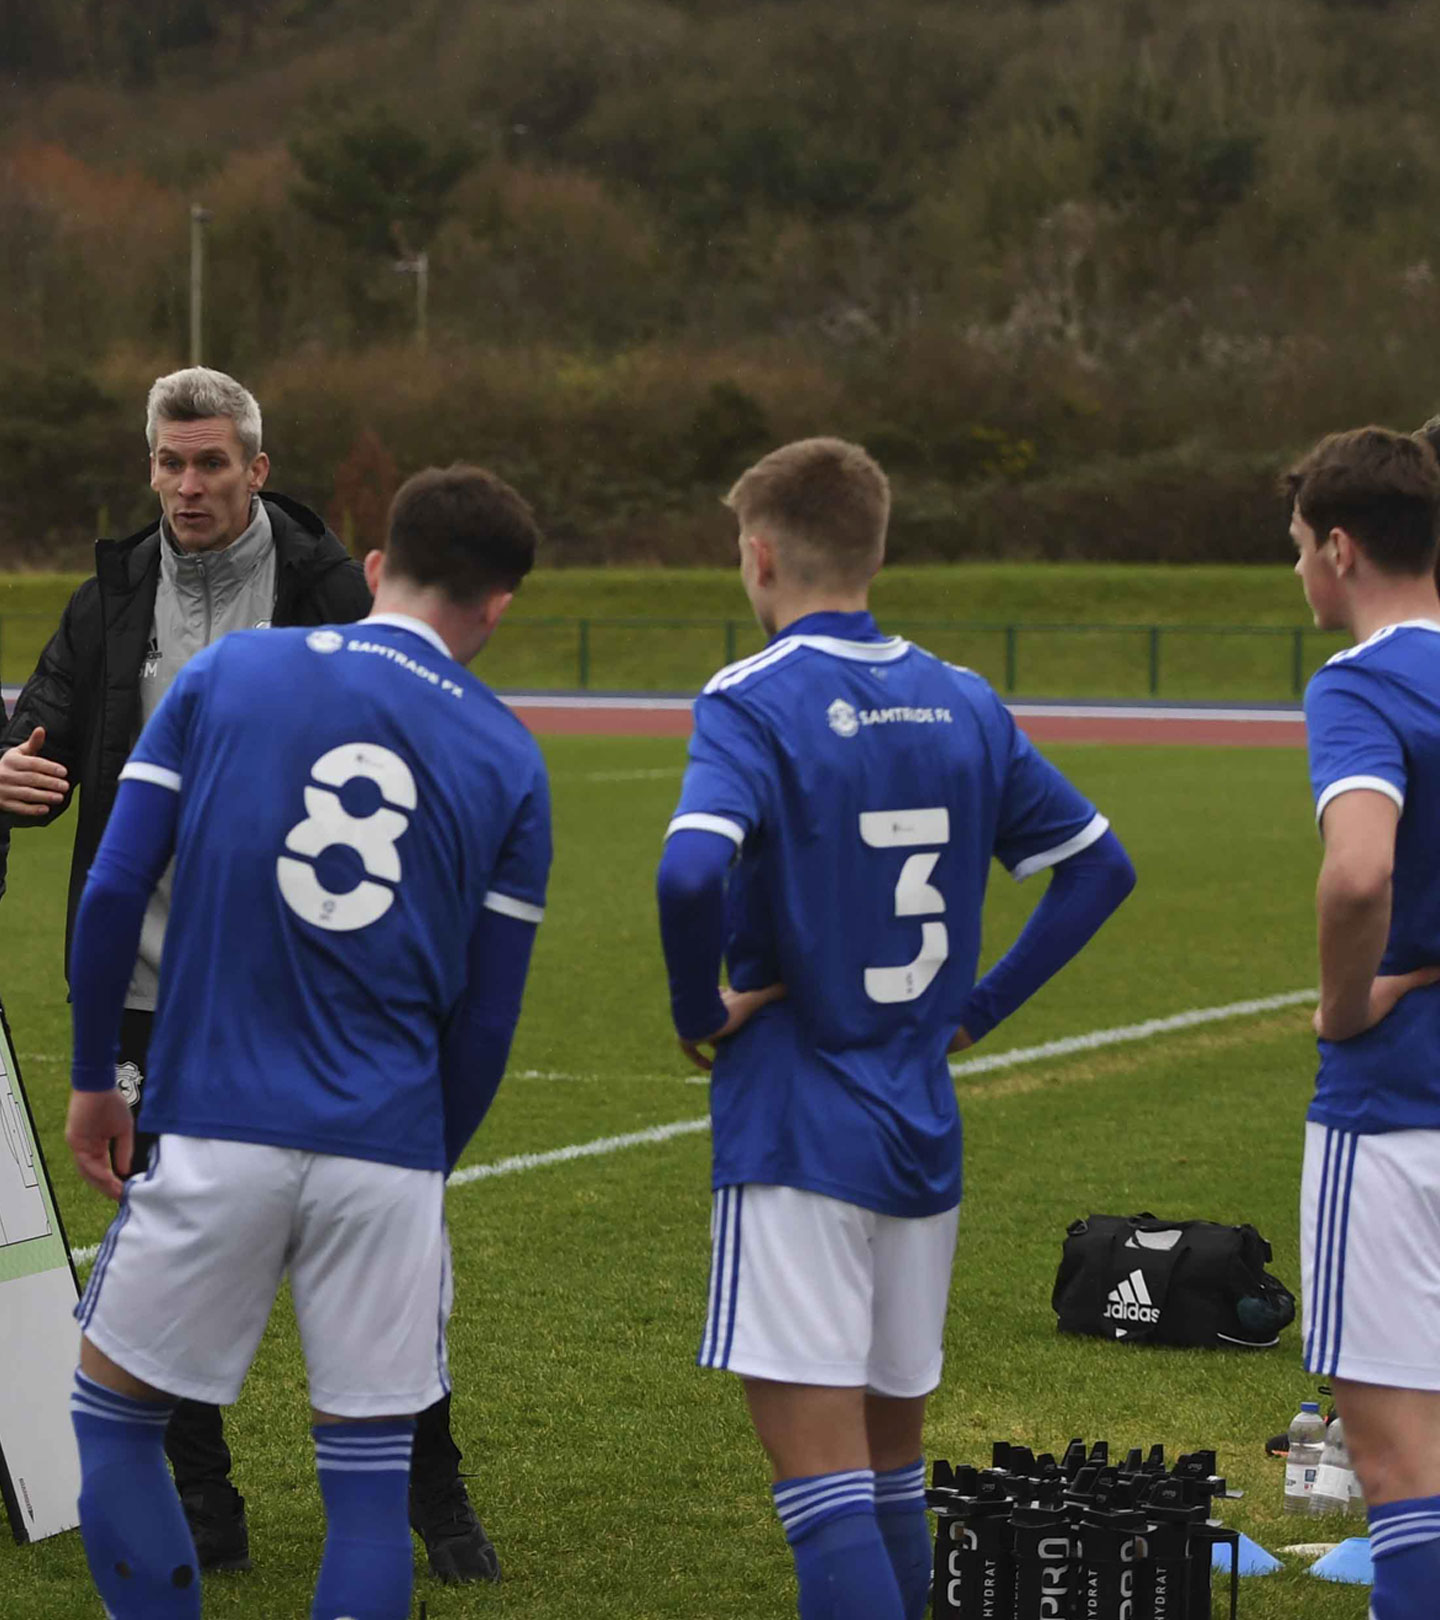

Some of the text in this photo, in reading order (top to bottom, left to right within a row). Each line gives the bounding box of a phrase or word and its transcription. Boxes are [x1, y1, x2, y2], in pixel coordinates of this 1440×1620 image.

[277, 742, 418, 932] 8
[859, 807, 950, 1004] 3
[982, 1559, 996, 1617] HYDRAT
